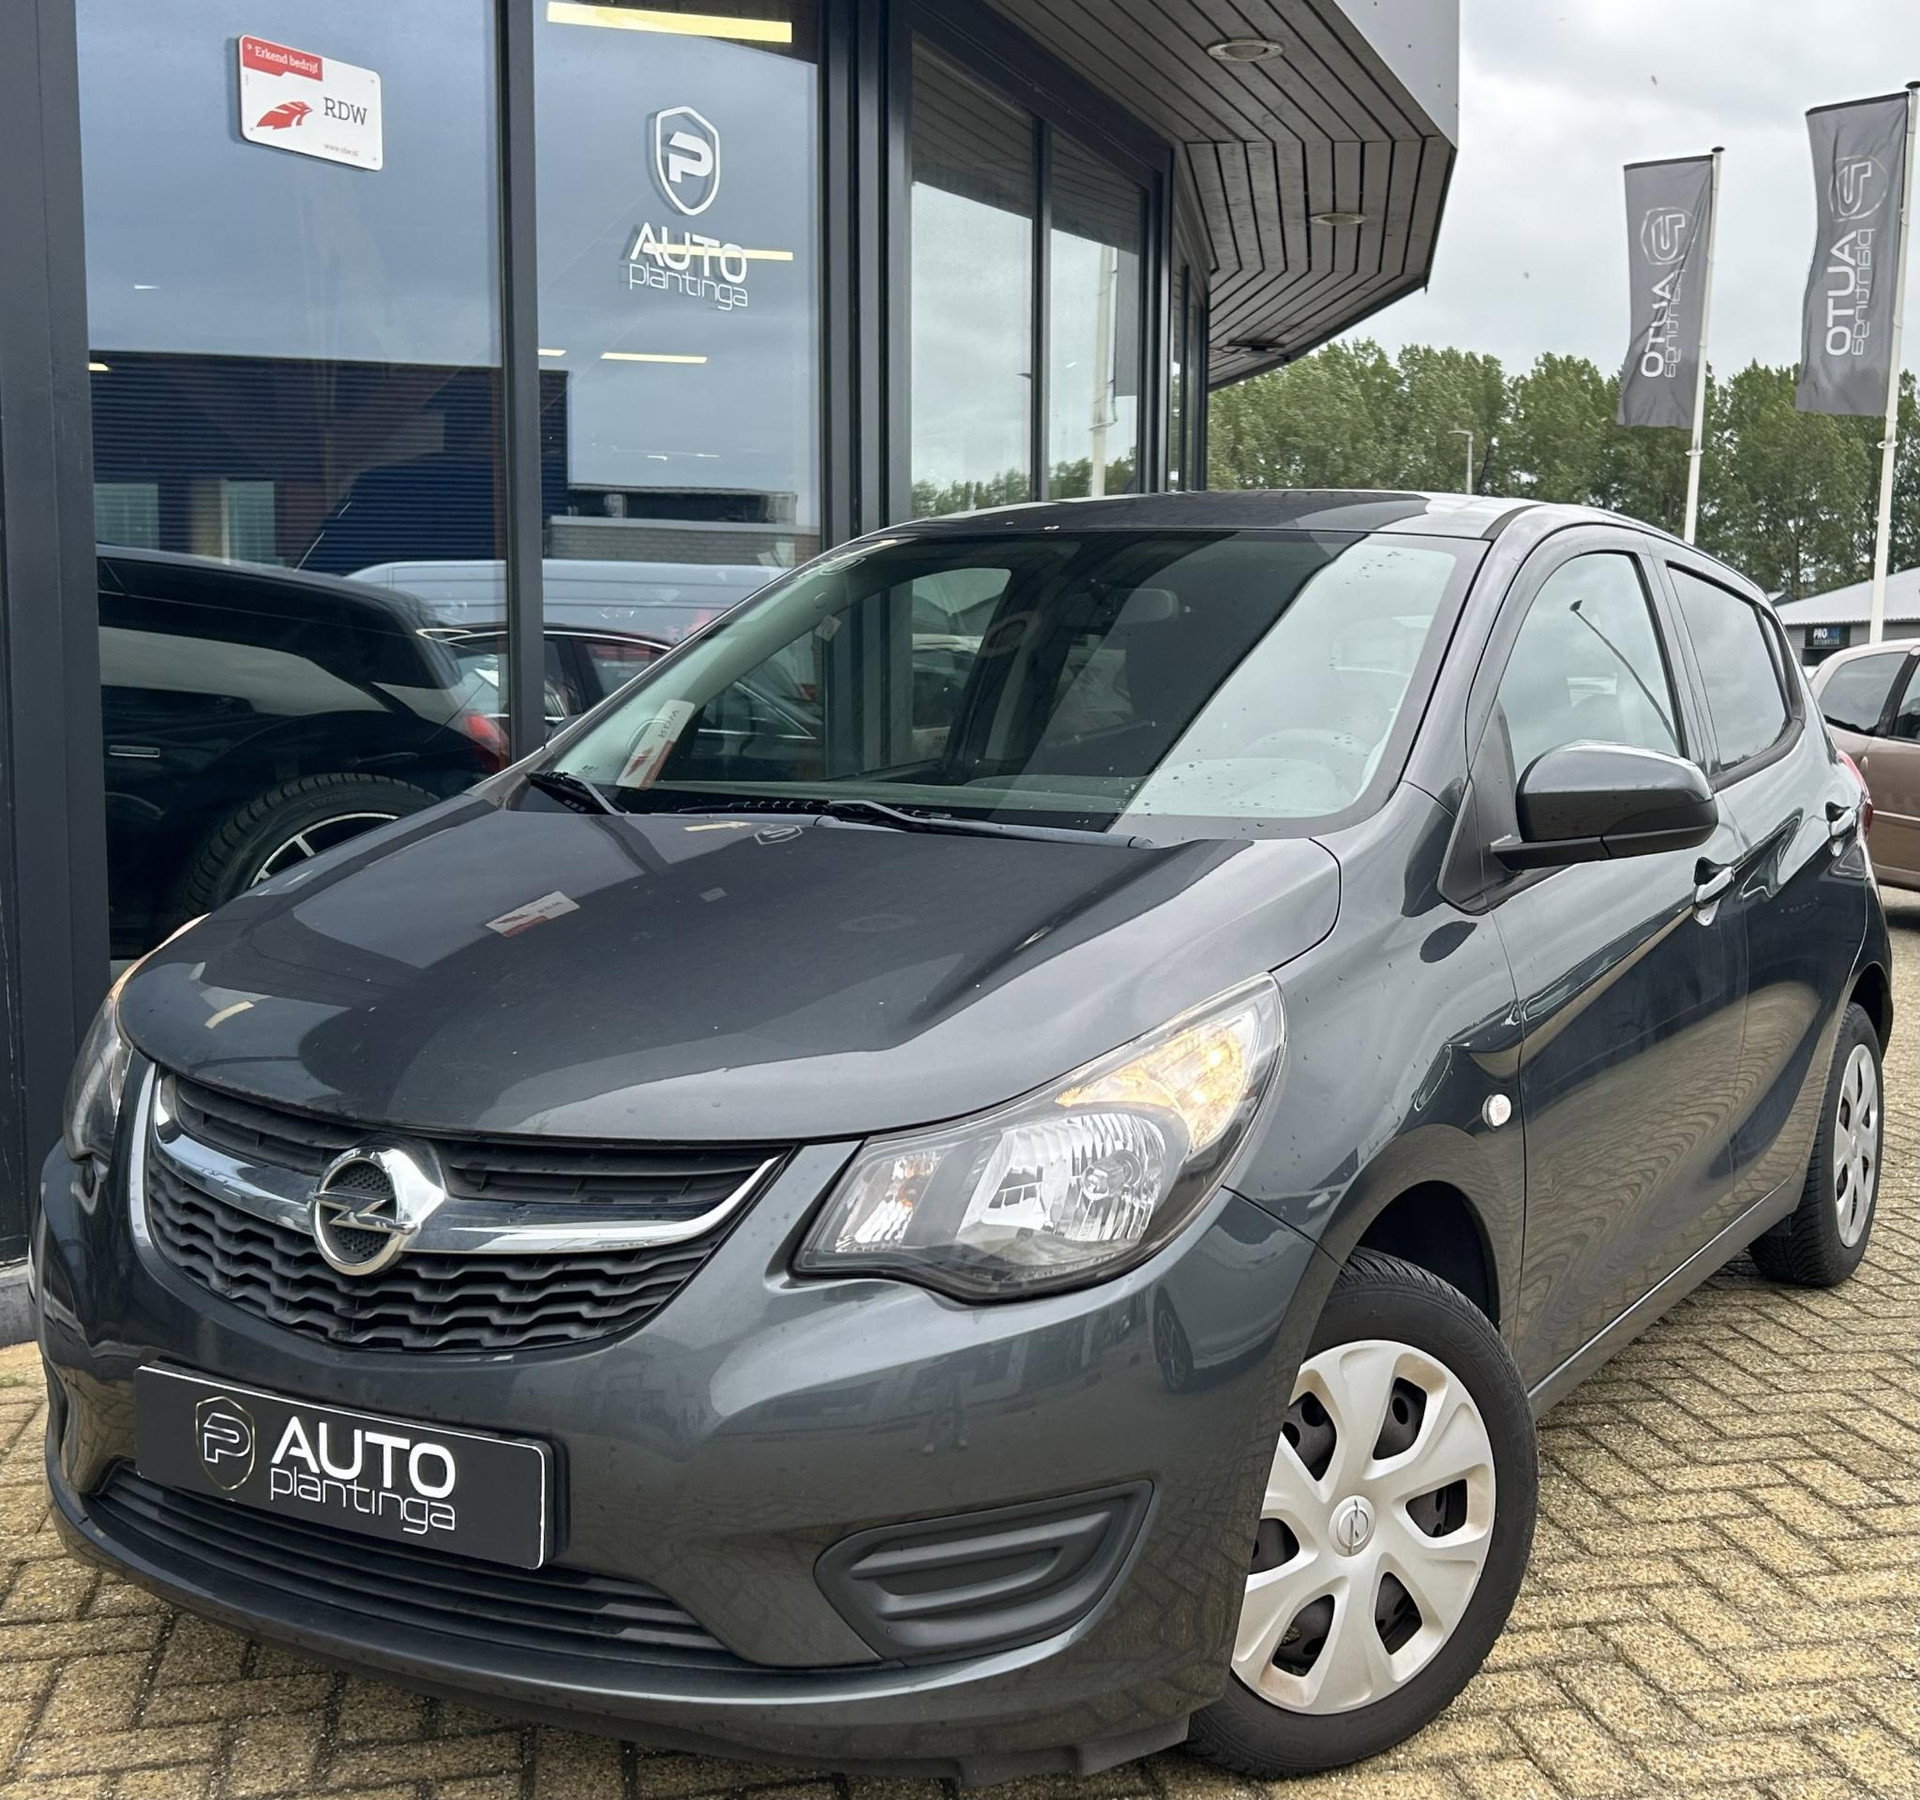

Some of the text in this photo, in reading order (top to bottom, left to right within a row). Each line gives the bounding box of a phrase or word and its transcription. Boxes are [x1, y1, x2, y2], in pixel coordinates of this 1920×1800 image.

[254, 45, 318, 75] Erkend bedrijf
[323, 96, 368, 126] RDW
[629, 222, 748, 284] AUTO
[629, 262, 748, 311] plantinga
[270, 1416, 456, 1499] AUTO
[270, 1467, 456, 1535] plantinga
